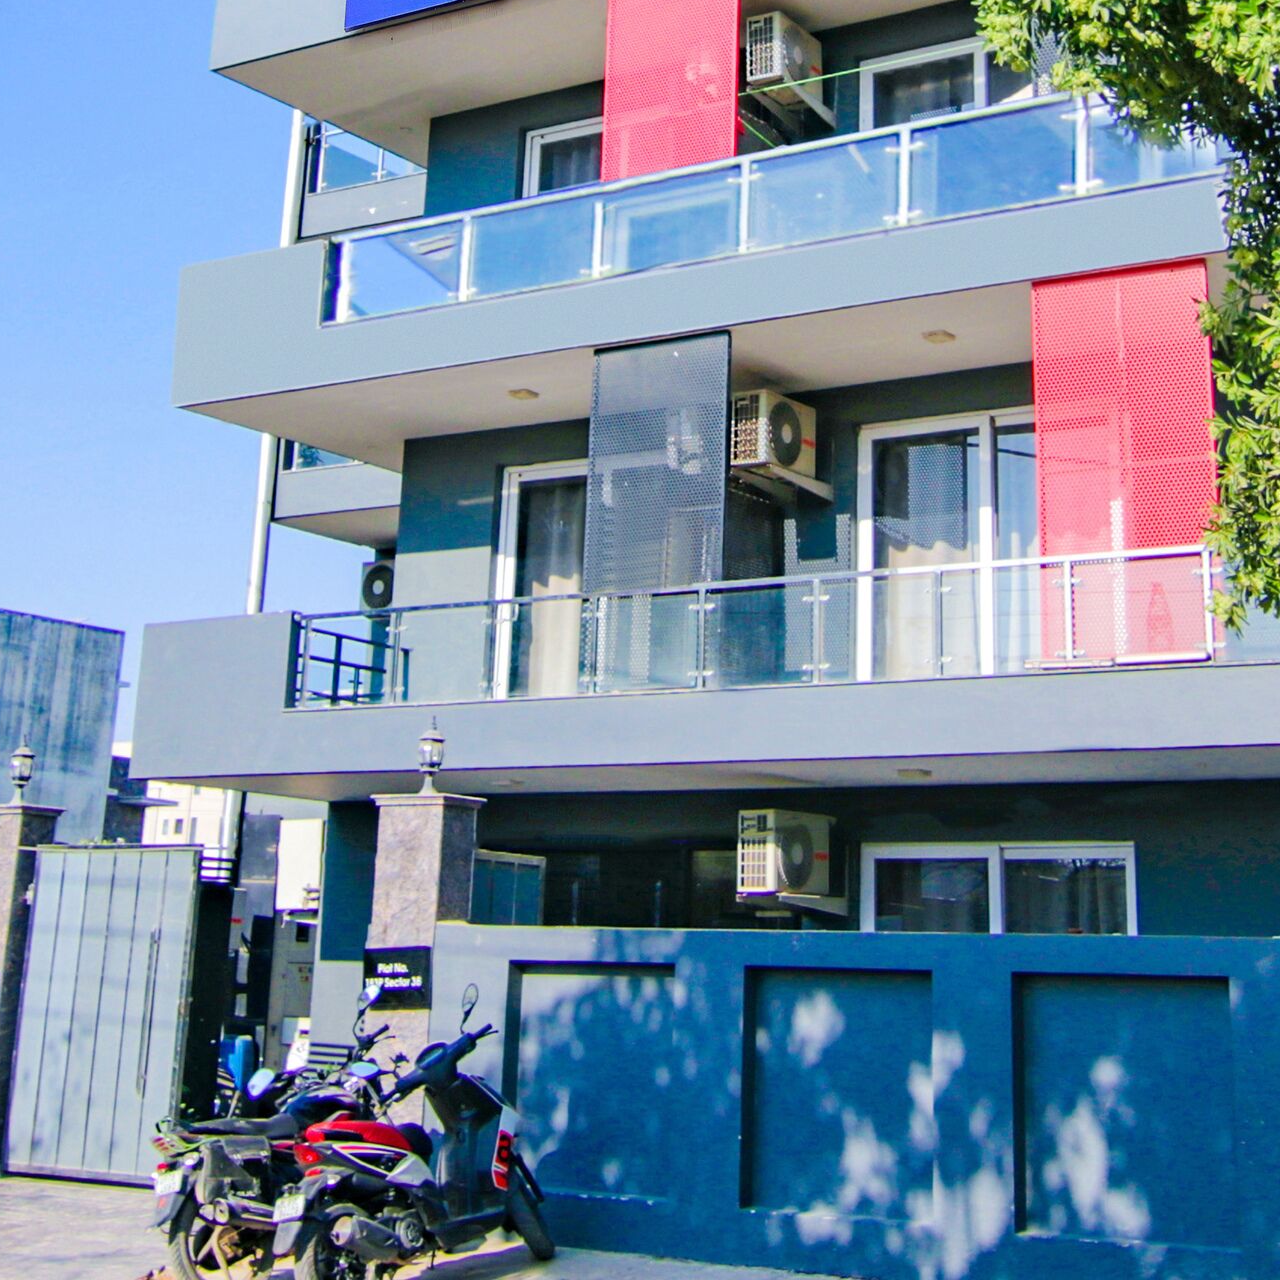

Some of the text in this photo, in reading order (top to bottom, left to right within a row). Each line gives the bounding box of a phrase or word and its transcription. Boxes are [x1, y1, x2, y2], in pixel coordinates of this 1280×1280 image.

[377, 962, 408, 973] Plot No.
[384, 976, 410, 987] Sector
